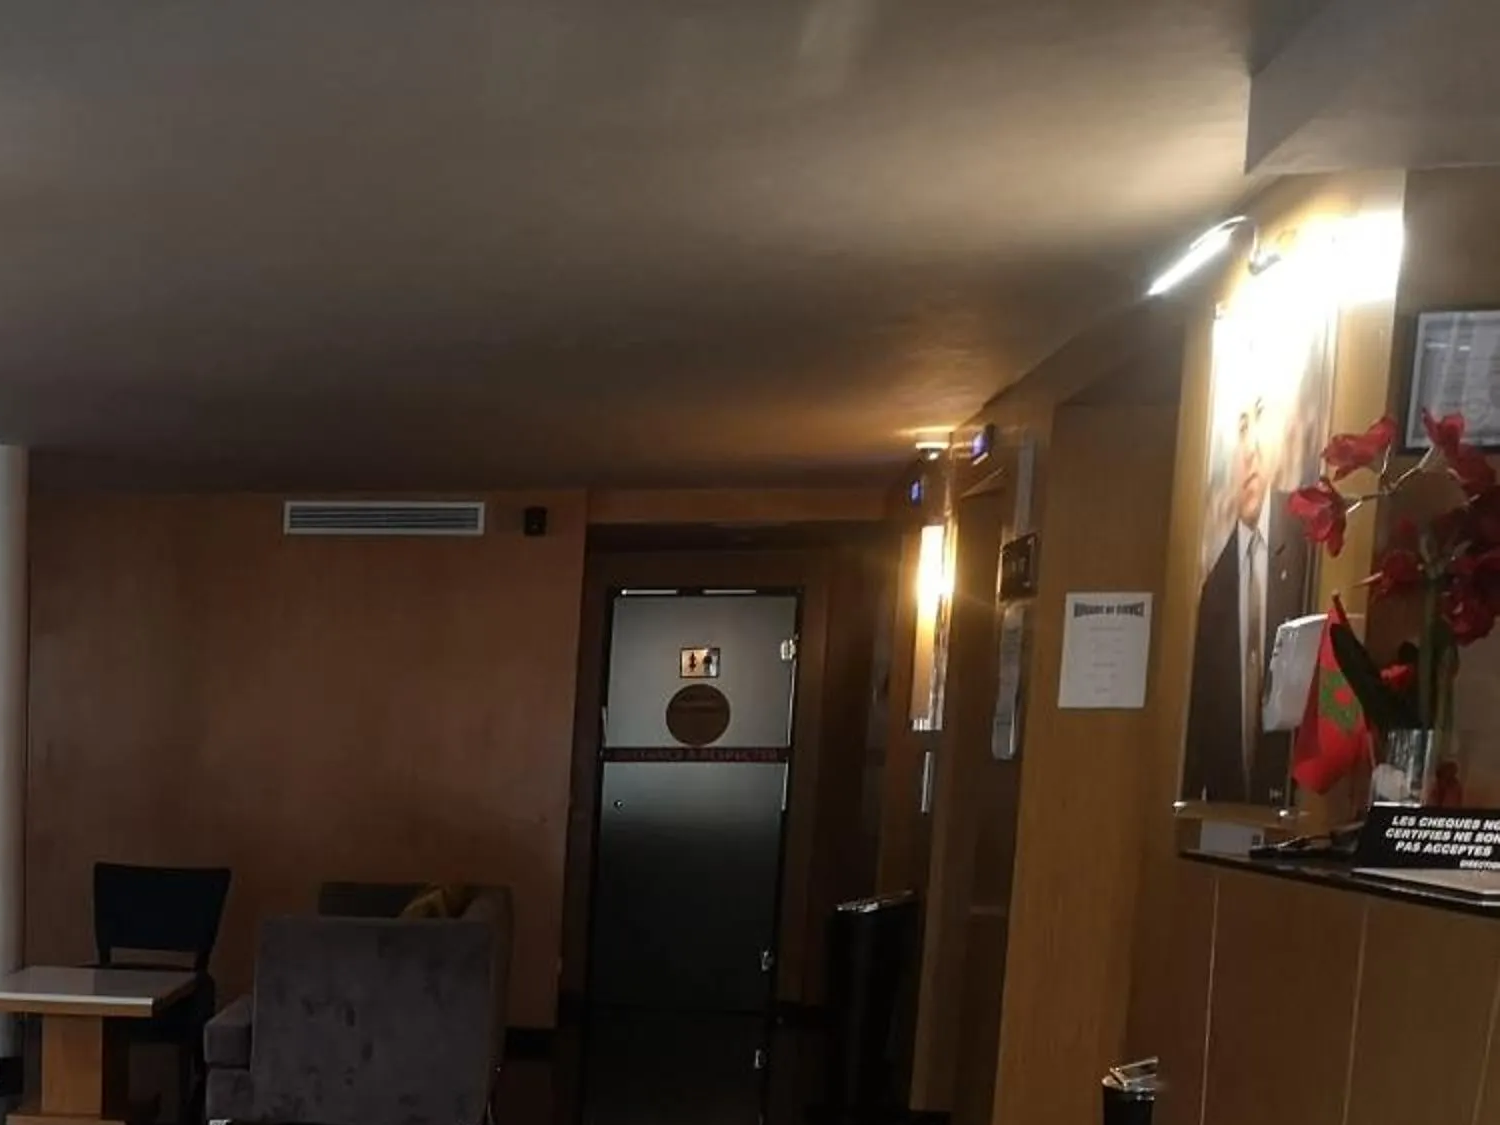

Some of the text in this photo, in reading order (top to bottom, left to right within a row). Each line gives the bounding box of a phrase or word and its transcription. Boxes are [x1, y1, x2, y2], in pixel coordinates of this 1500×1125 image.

[1391, 815, 1417, 827] LES
[1418, 817, 1481, 830] CHEQUES
[1385, 828, 1451, 841] CERTIFIES
[1453, 831, 1473, 842] NE
[1395, 841, 1493, 857] PAS ACCEPTES
